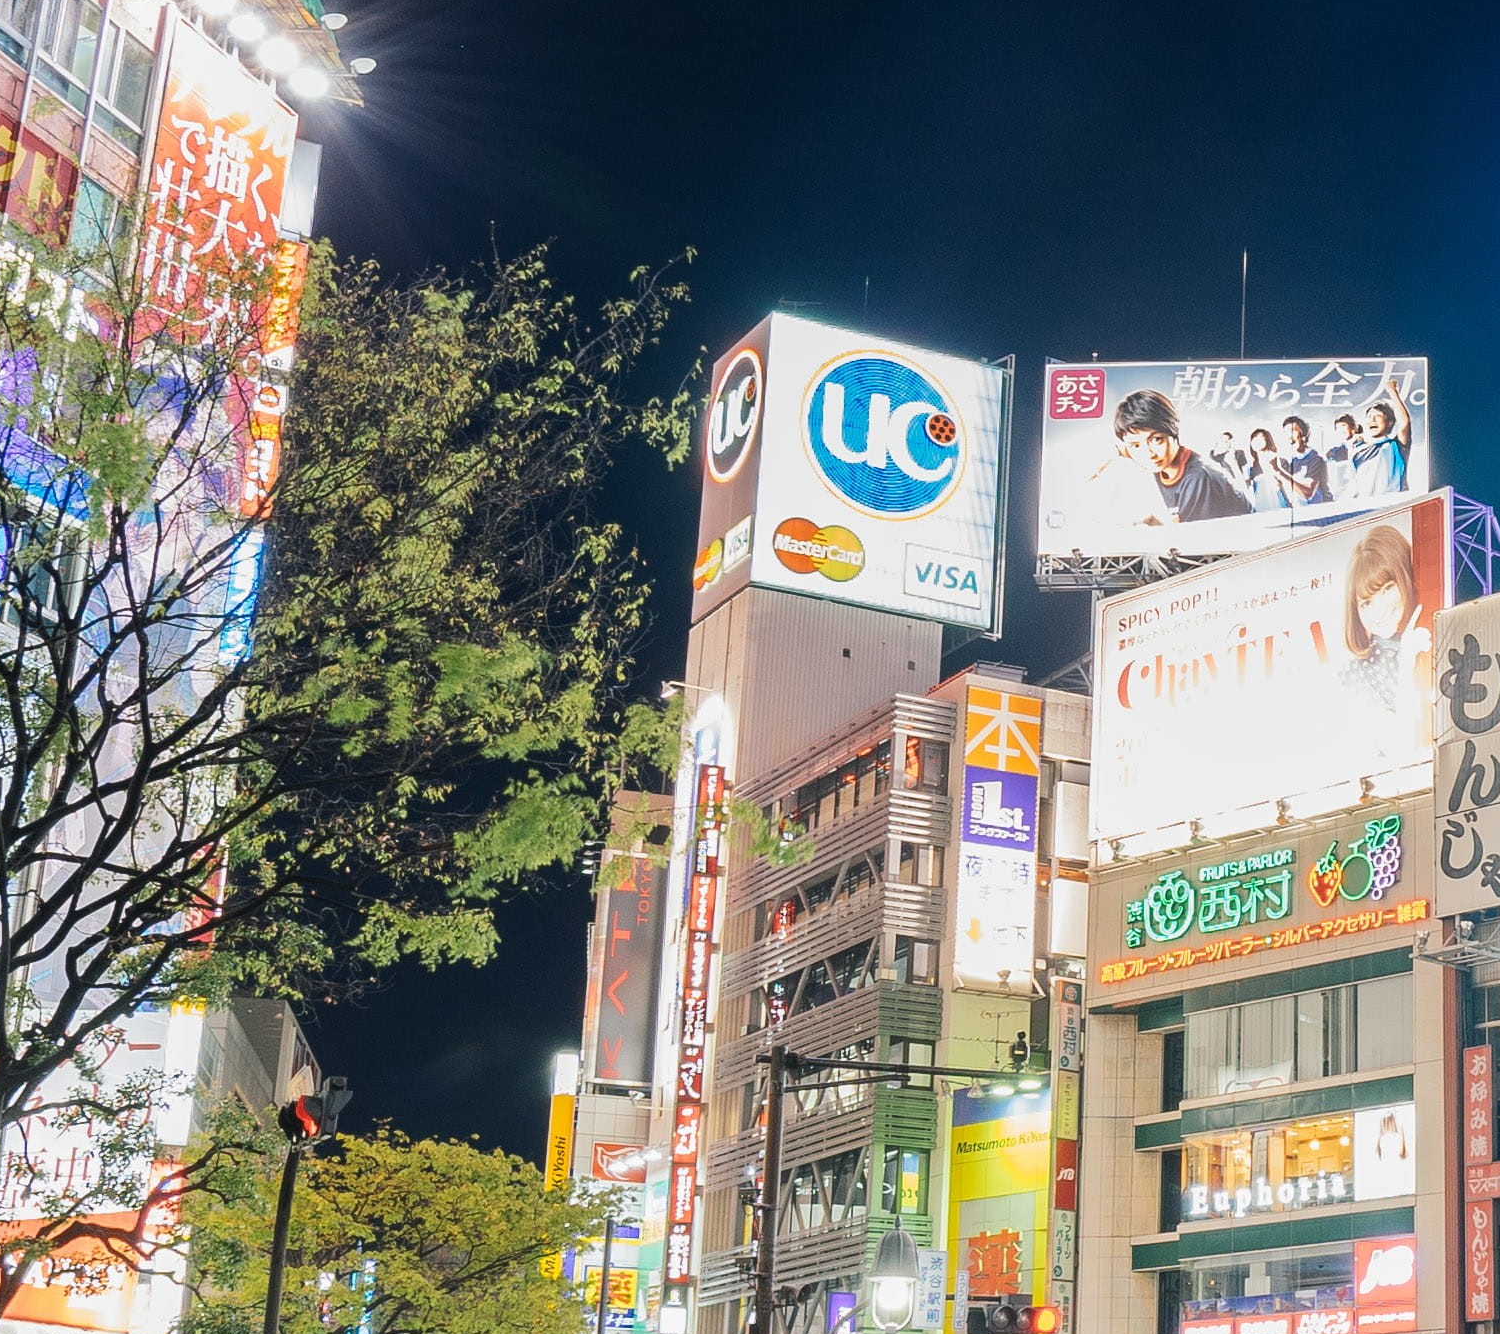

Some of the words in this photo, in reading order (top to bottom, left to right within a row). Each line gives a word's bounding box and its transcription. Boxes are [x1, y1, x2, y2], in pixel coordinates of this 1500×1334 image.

[1055, 373, 1101, 396] あさ
[1055, 394, 1101, 415] チャン
[1170, 361, 1427, 412] 朝から全力。
[711, 375, 757, 455] UC
[820, 378, 955, 484] UC
[772, 531, 867, 567] MasterCard
[915, 561, 979, 594] VISA
[1117, 608, 1162, 633] SPICY
[1169, 587, 1219, 616] POP!!
[964, 689, 1042, 772] 本
[1200, 848, 1294, 883] FRUITS&PARLOR
[1126, 901, 1143, 948] 渋谷
[1200, 870, 1293, 935] 西村
[1061, 1025, 1077, 1057] 西村
[1469, 1053, 1488, 1157] お好み焼
[956, 1135, 1016, 1157] Matsumoto
[1189, 1170, 1347, 1219] Euphoria
[967, 1228, 1023, 1297] 薬
[1359, 1245, 1415, 1295] JTB
[1471, 1206, 1490, 1314] もんじゃ焼
[925, 1257, 944, 1325] 渋谷駅前
